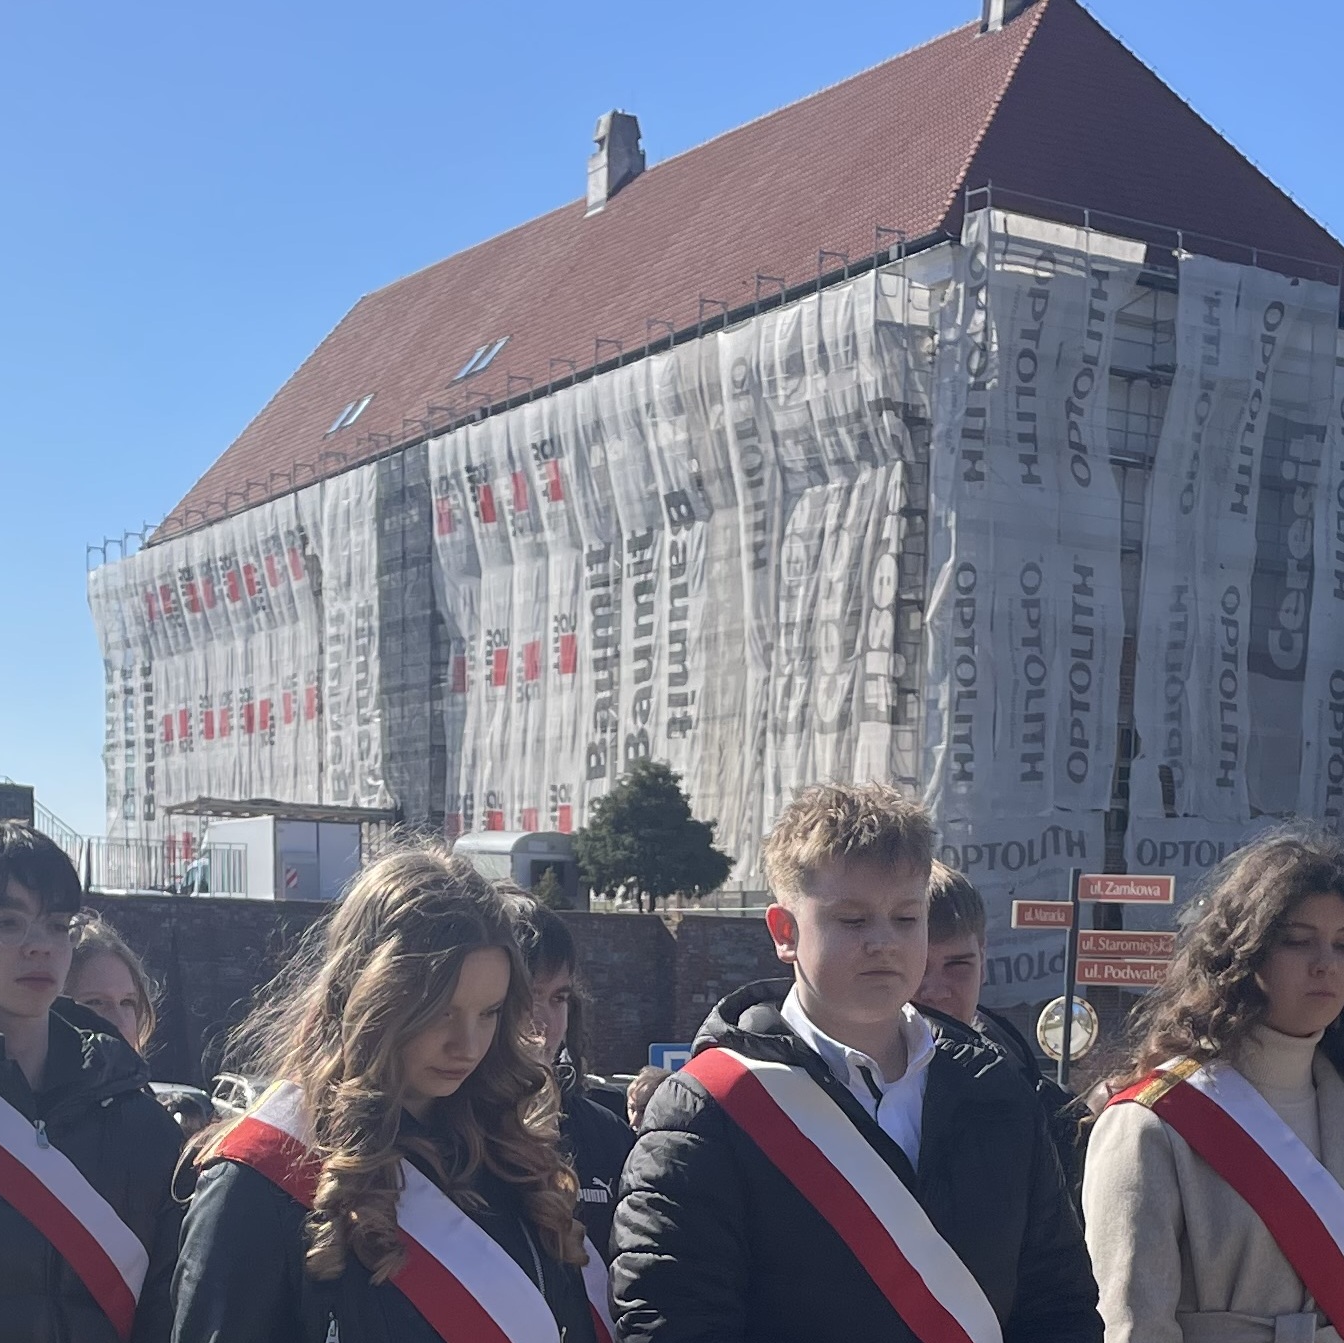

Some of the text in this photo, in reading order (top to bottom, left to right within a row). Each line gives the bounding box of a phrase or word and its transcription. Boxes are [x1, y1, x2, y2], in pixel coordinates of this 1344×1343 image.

[1015, 250, 1056, 485] OPTOLITH
[1066, 270, 1109, 487] OPTOLITH
[1230, 301, 1285, 514] OPTOLITH
[586, 543, 613, 780] Baumit
[624, 527, 655, 760] Baumit
[665, 490, 697, 739] Baumit
[1268, 434, 1323, 671] Ceresit
[953, 562, 977, 782] OPTOLITH
[1020, 562, 1046, 782] OPTOLITH
[1067, 565, 1094, 784] OPTOLITH
[1216, 585, 1240, 787] OPTOLITH
[941, 824, 1087, 873] OPTOLITH
[1082, 936, 1096, 951] ul.
[1090, 881, 1161, 897] ul. Zamkowa
[1084, 964, 1101, 979] ul.
